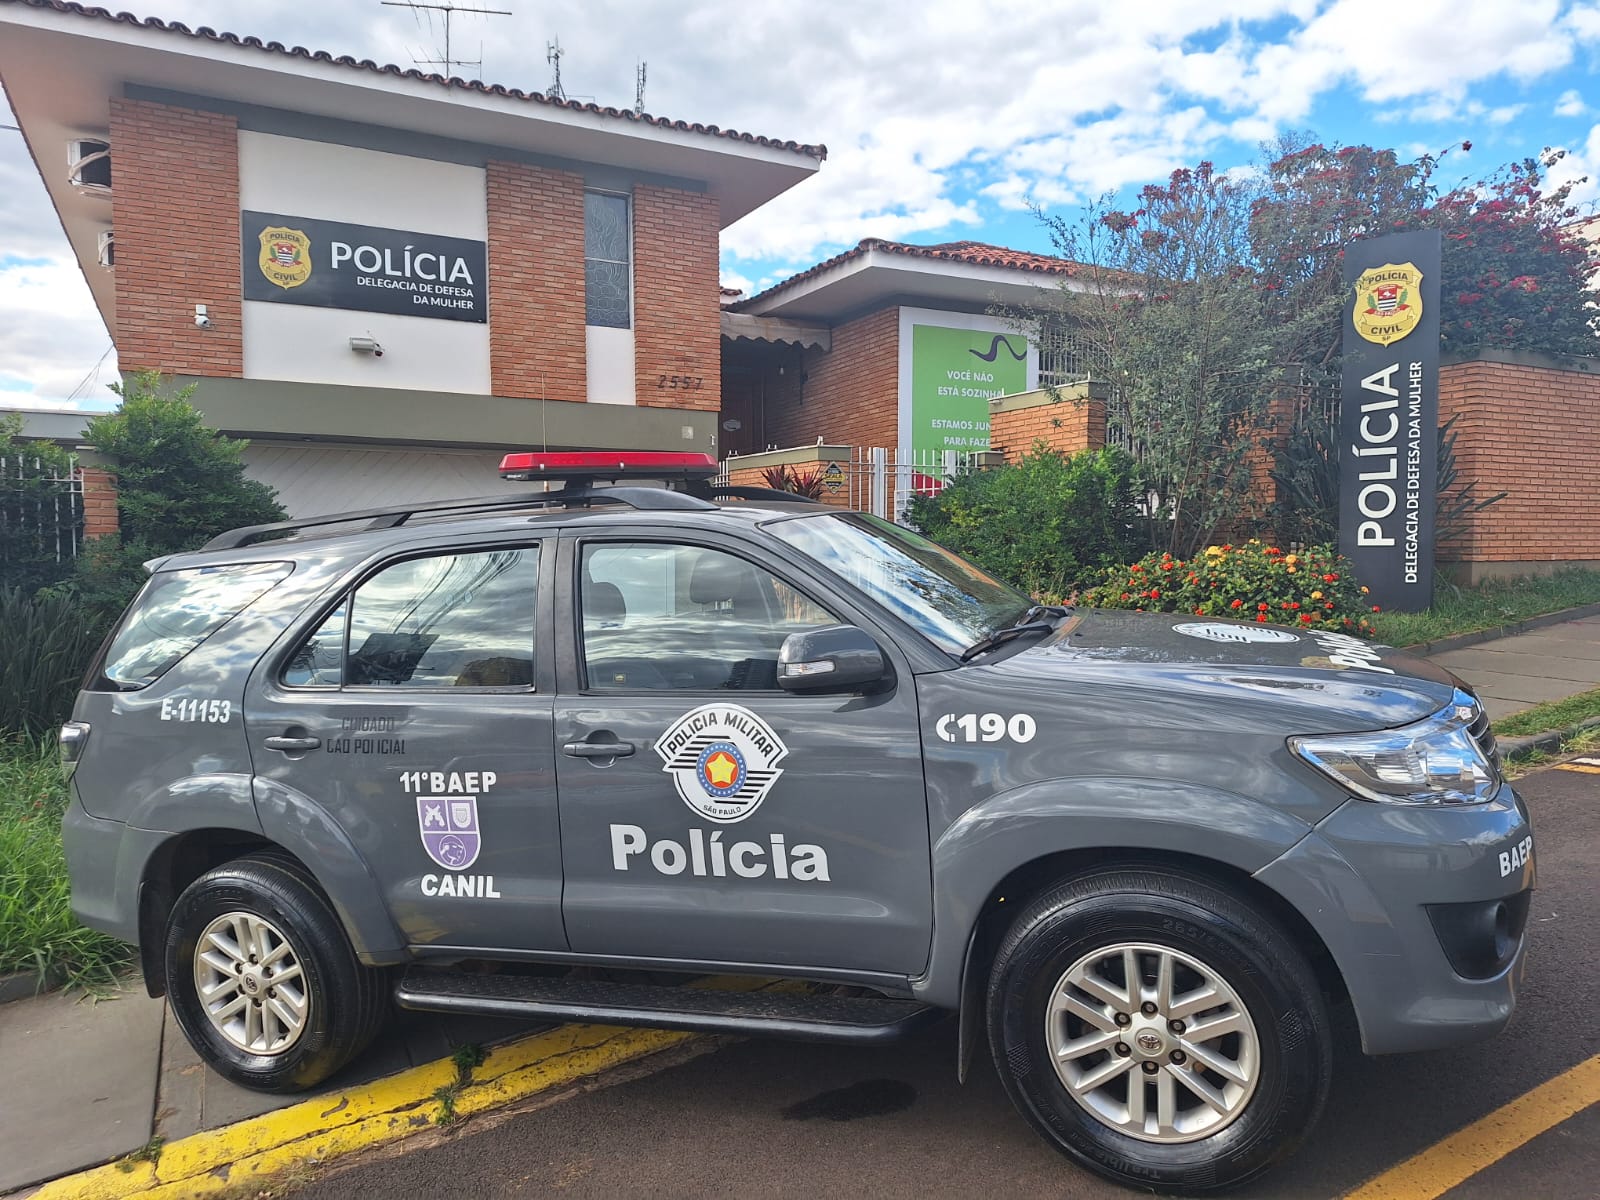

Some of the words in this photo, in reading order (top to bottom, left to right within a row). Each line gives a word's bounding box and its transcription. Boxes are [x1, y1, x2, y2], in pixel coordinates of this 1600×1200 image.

[330, 242, 474, 285] POLÍCIA
[274, 272, 298, 280] CIVIL
[357, 276, 418, 291] DELEGACIA
[419, 283, 434, 294] DE
[435, 285, 474, 298] DEFESA
[414, 294, 430, 305] DA
[431, 296, 474, 310] MULHER
[1371, 325, 1402, 335] CIVIL
[658, 374, 703, 390] 2557
[947, 370, 971, 380] VOCÊ
[974, 371, 994, 383] NÃO
[938, 384, 960, 396] ESTÁ
[1408, 361, 1422, 417] MULHER
[932, 419, 972, 430] ESTAMOS
[1408, 418, 1420, 438] DA
[944, 436, 966, 446] PARA
[1352, 362, 1400, 547] POLÍCIA
[1408, 440, 1420, 489] DEFESA
[1407, 491, 1419, 509] DE
[1404, 510, 1418, 583] DELEGACIA
[160, 698, 231, 724] E-11153
[342, 716, 394, 732] CUIDADO
[724, 712, 774, 758] MILITAR
[704, 804, 717, 814] SÃO
[718, 806, 742, 816] PAULO
[610, 824, 832, 882] Polícia
[1498, 835, 1532, 878] BAEP
[420, 874, 501, 898] CANIL
